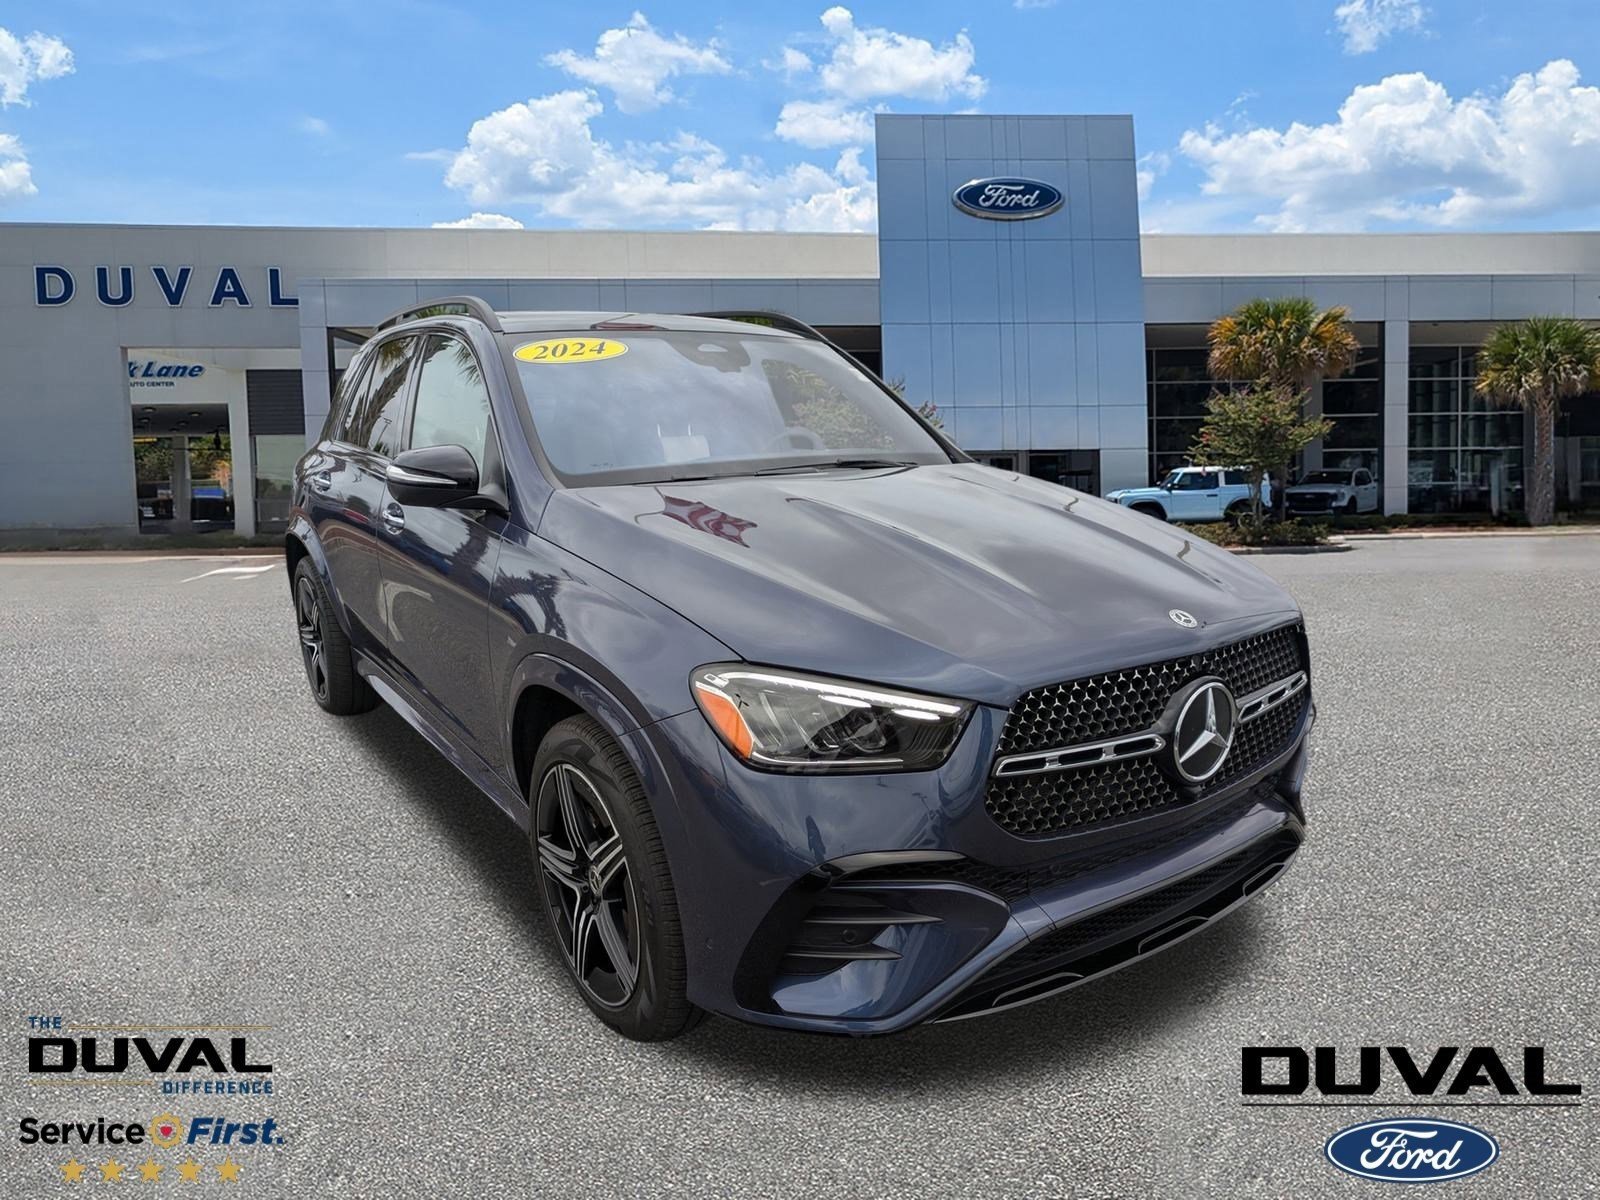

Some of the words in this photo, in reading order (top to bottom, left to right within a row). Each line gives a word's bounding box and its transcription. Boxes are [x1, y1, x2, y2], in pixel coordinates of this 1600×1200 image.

[978, 184, 1041, 207] Ford
[33, 265, 299, 307] DUVAL
[532, 341, 606, 360] 2024
[141, 361, 206, 378] Lane
